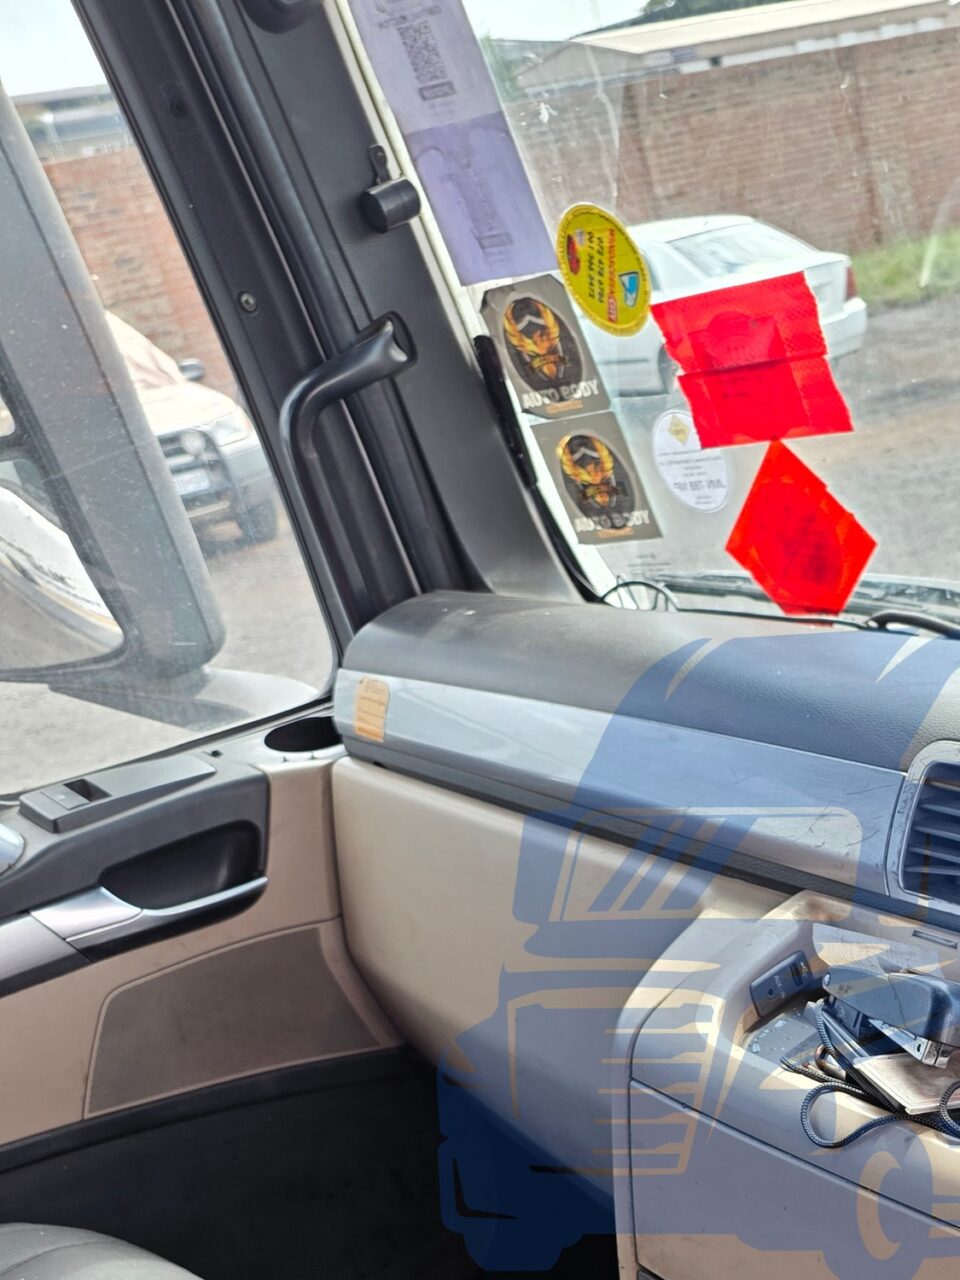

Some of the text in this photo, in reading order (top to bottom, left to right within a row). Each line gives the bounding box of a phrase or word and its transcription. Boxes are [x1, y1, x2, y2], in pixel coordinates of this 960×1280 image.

[522, 388, 559, 409] AUTO
[561, 379, 600, 401] BODY
[574, 514, 612, 533] AUTO
[612, 509, 651, 528] BODY
